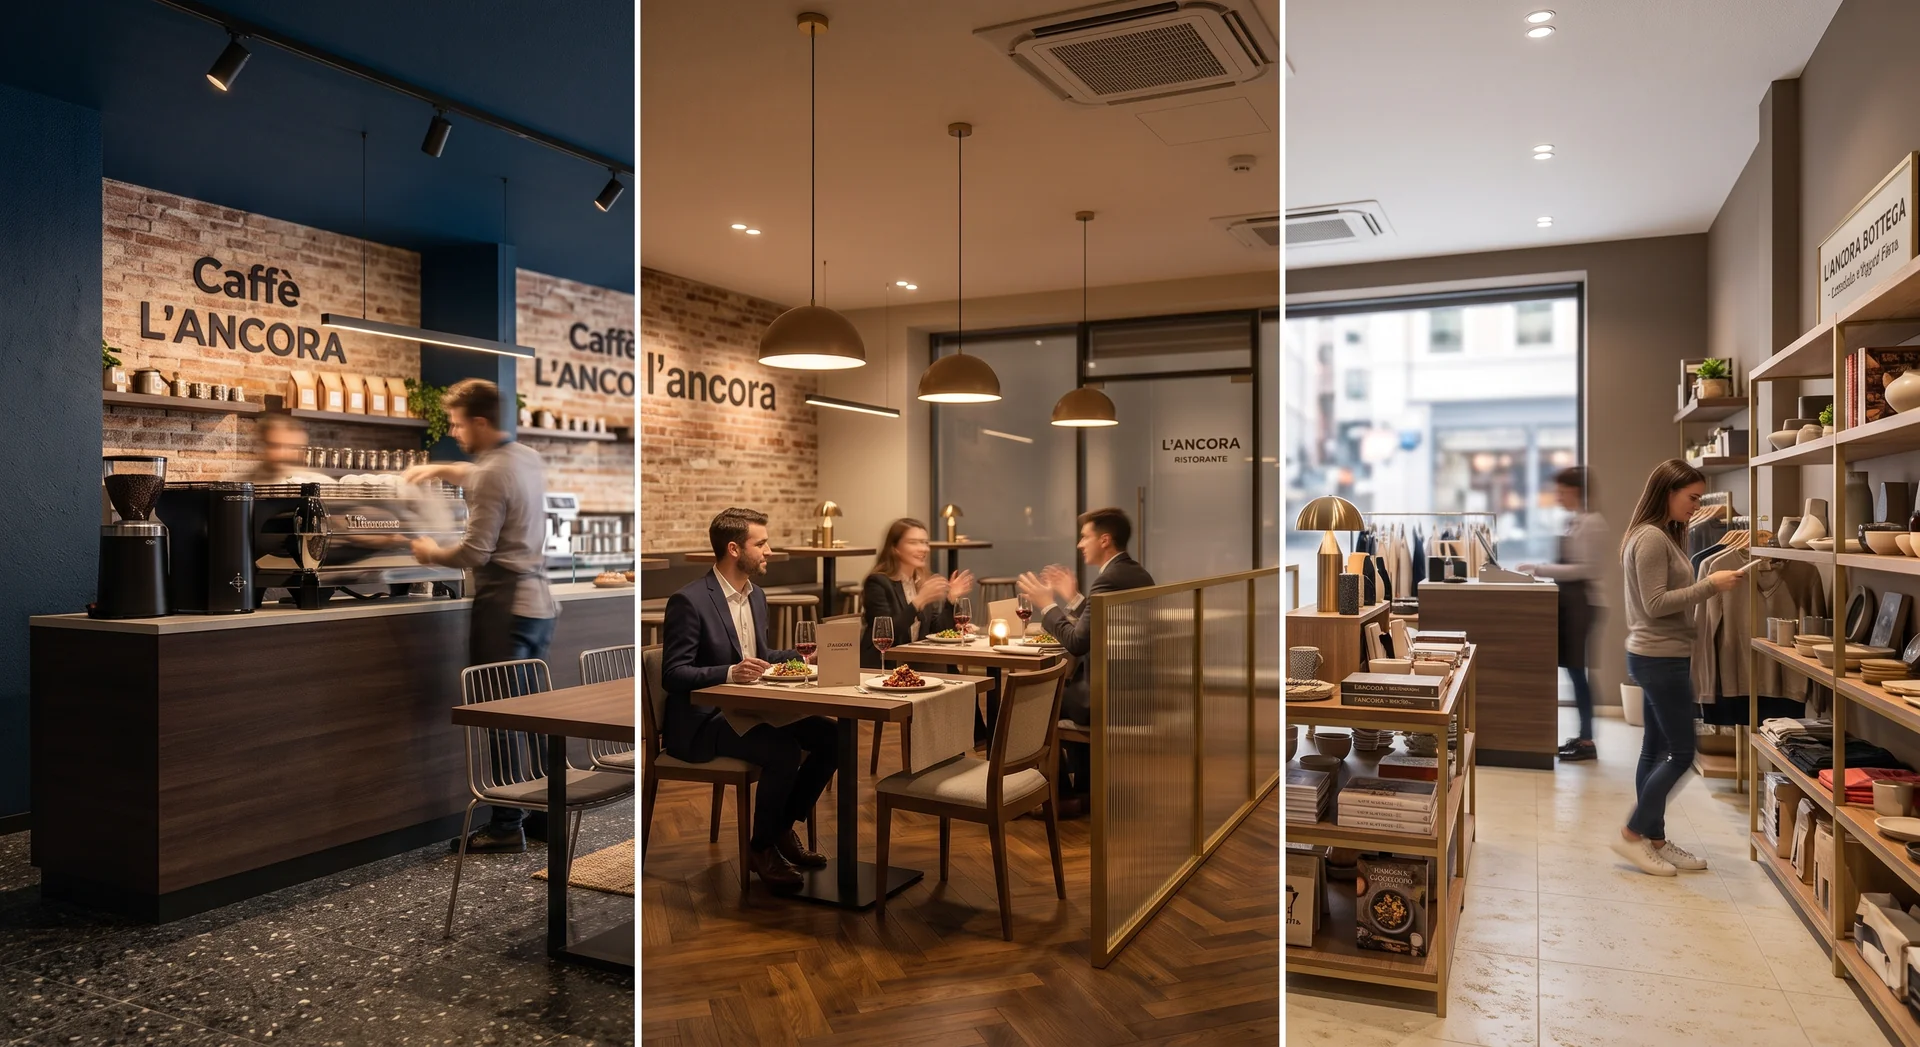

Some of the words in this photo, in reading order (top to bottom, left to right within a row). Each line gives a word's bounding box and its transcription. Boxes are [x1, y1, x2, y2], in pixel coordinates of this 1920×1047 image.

[1824, 237, 1861, 282] L'ANCORA
[1863, 197, 1906, 251] BOTTEGA
[193, 256, 300, 307] Caffè
[141, 300, 347, 364] L'ANCORA
[647, 352, 776, 411] l'ancora
[1162, 437, 1241, 451] L'ANCORA
[1174, 455, 1228, 464] RISTORANTE
